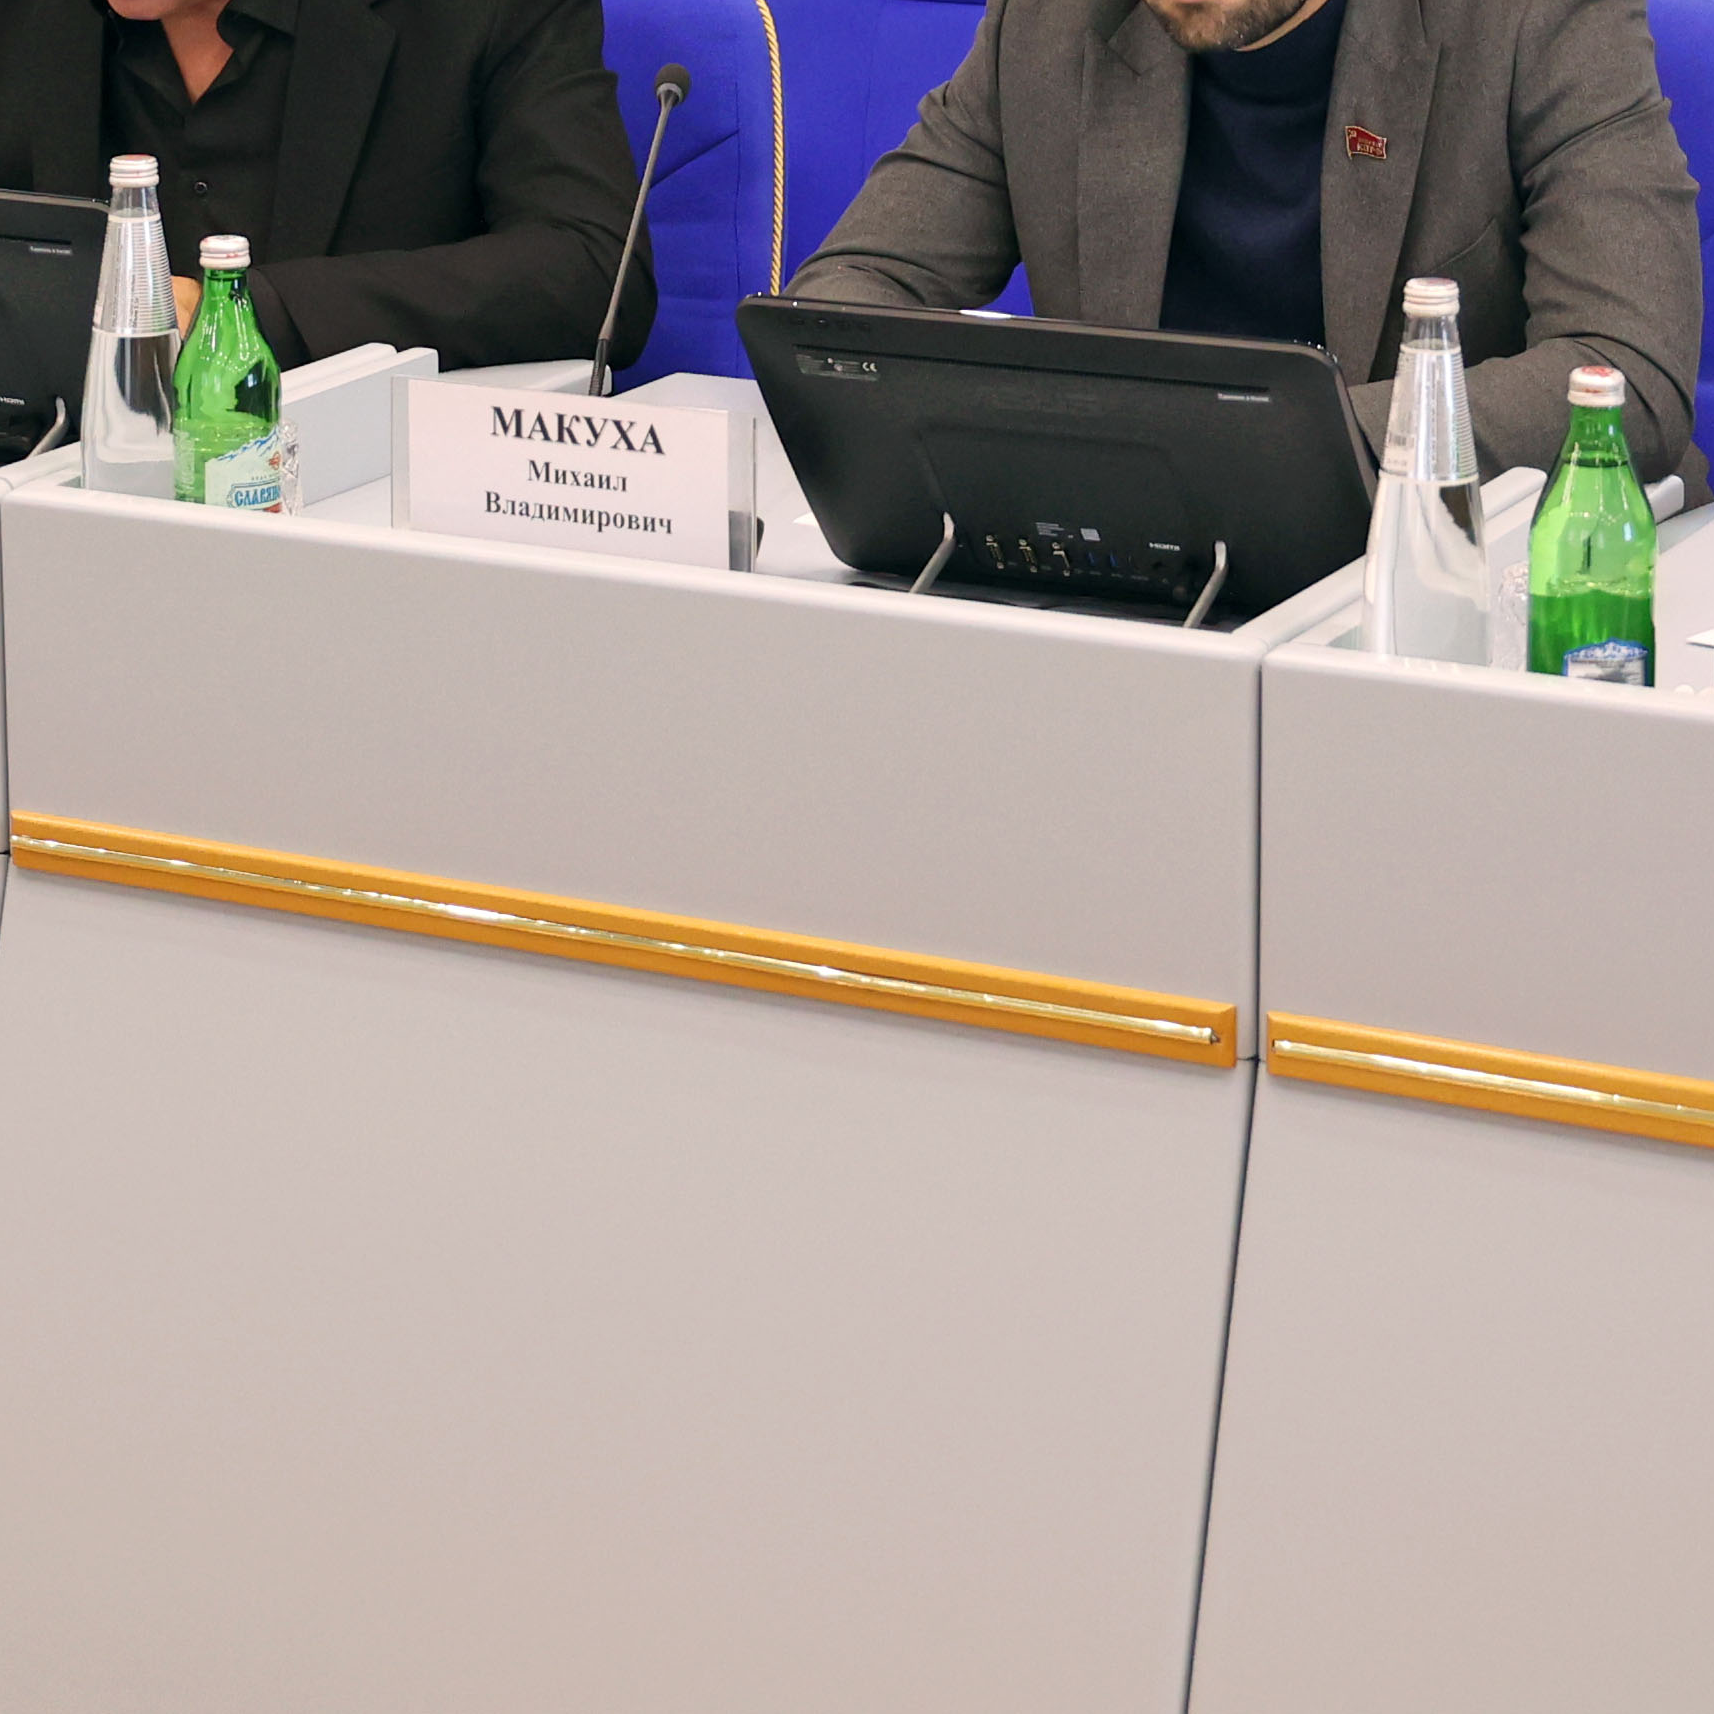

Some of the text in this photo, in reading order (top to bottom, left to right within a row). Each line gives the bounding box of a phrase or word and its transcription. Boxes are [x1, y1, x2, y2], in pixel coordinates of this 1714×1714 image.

[490, 405, 665, 456] МАКУХА
[527, 459, 628, 493] Михаил
[483, 491, 673, 535] Владимирович
